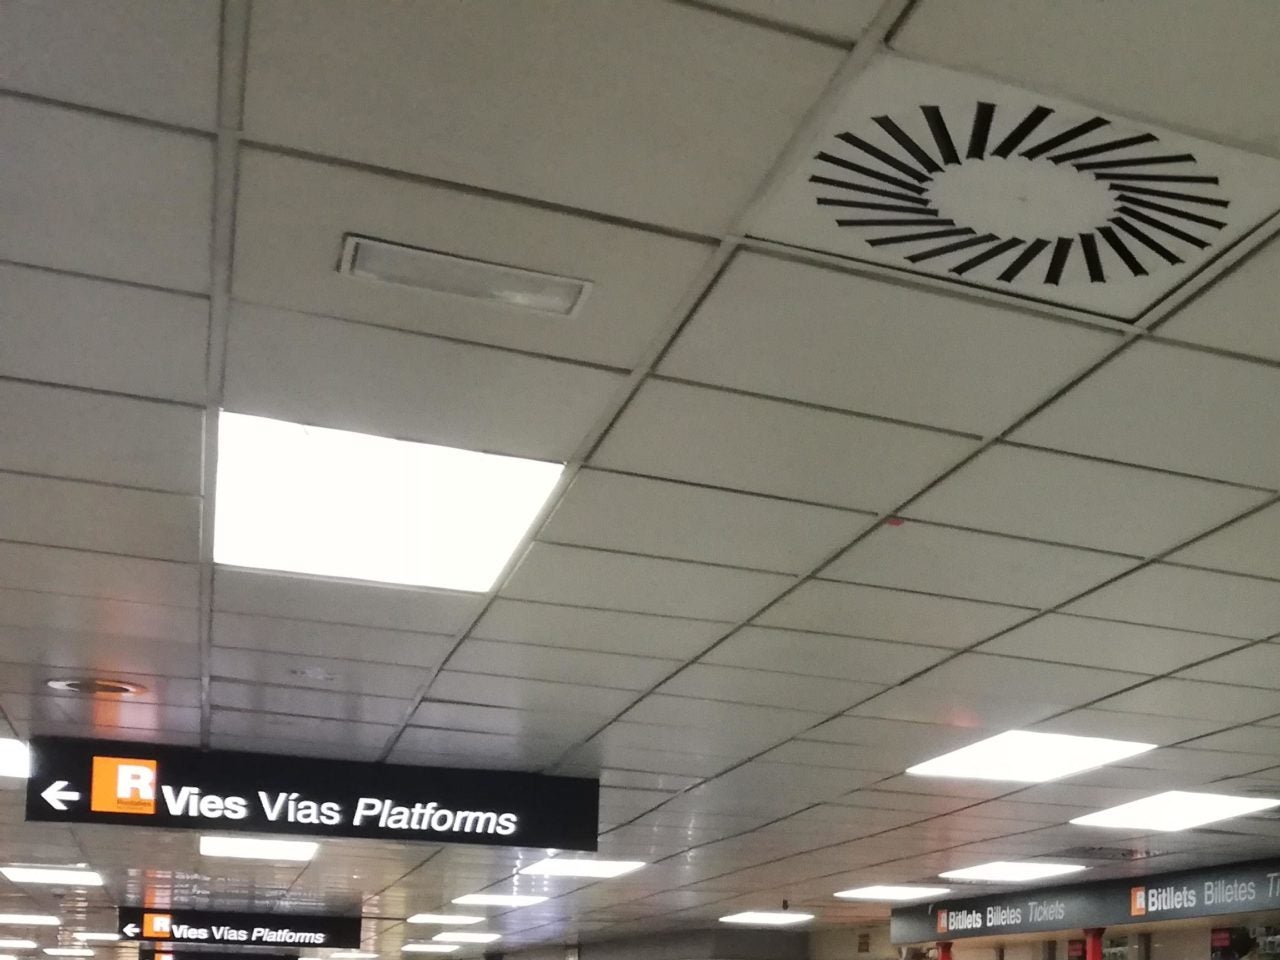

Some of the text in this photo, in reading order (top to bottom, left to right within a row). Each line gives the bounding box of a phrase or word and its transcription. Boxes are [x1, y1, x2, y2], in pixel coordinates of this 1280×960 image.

[117, 764, 156, 800] R
[162, 785, 518, 835] Vies Vías Platforms
[1148, 886, 1196, 912] Bitllets
[1204, 880, 1256, 905] Billetes
[948, 900, 1066, 931] Bitllets Billetes Tickets
[172, 924, 209, 939] Vies
[251, 927, 326, 944] Platforms
